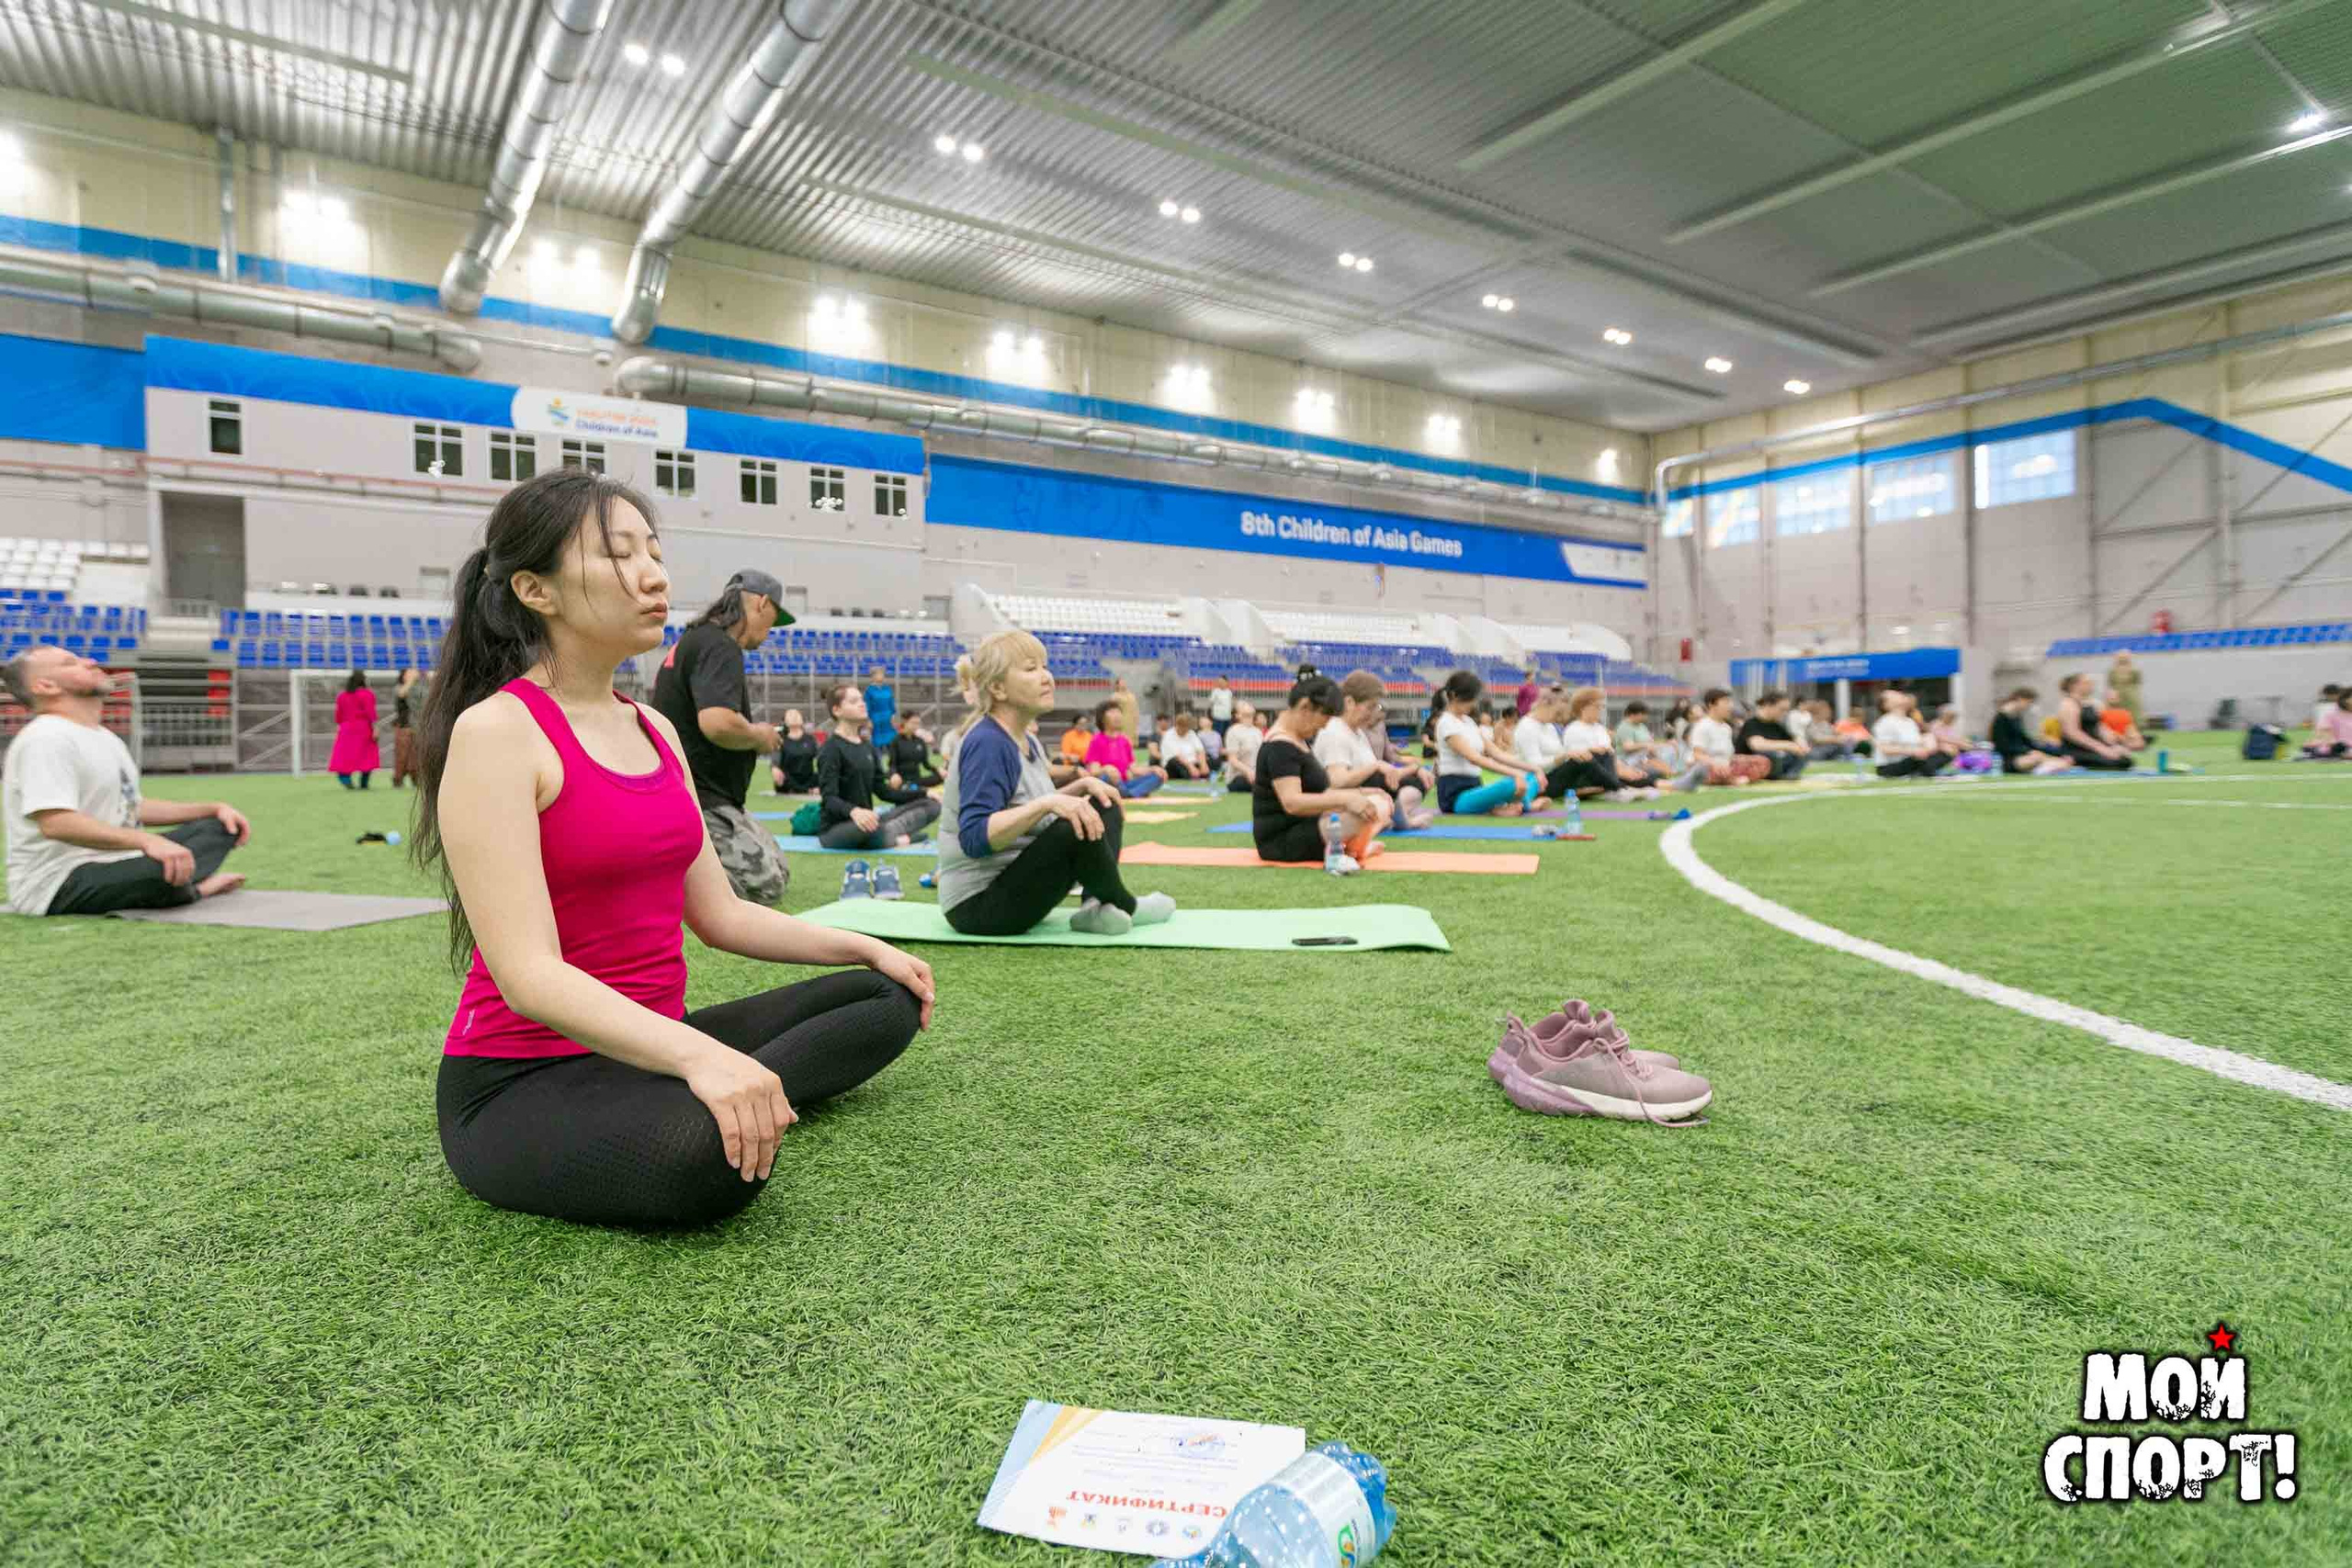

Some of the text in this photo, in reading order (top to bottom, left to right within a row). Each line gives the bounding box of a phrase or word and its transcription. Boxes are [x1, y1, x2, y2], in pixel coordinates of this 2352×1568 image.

[1240, 511, 1463, 558] 8th Children of Asia Games
[1066, 1490, 1228, 1518] СЕРТИФИКАТ
